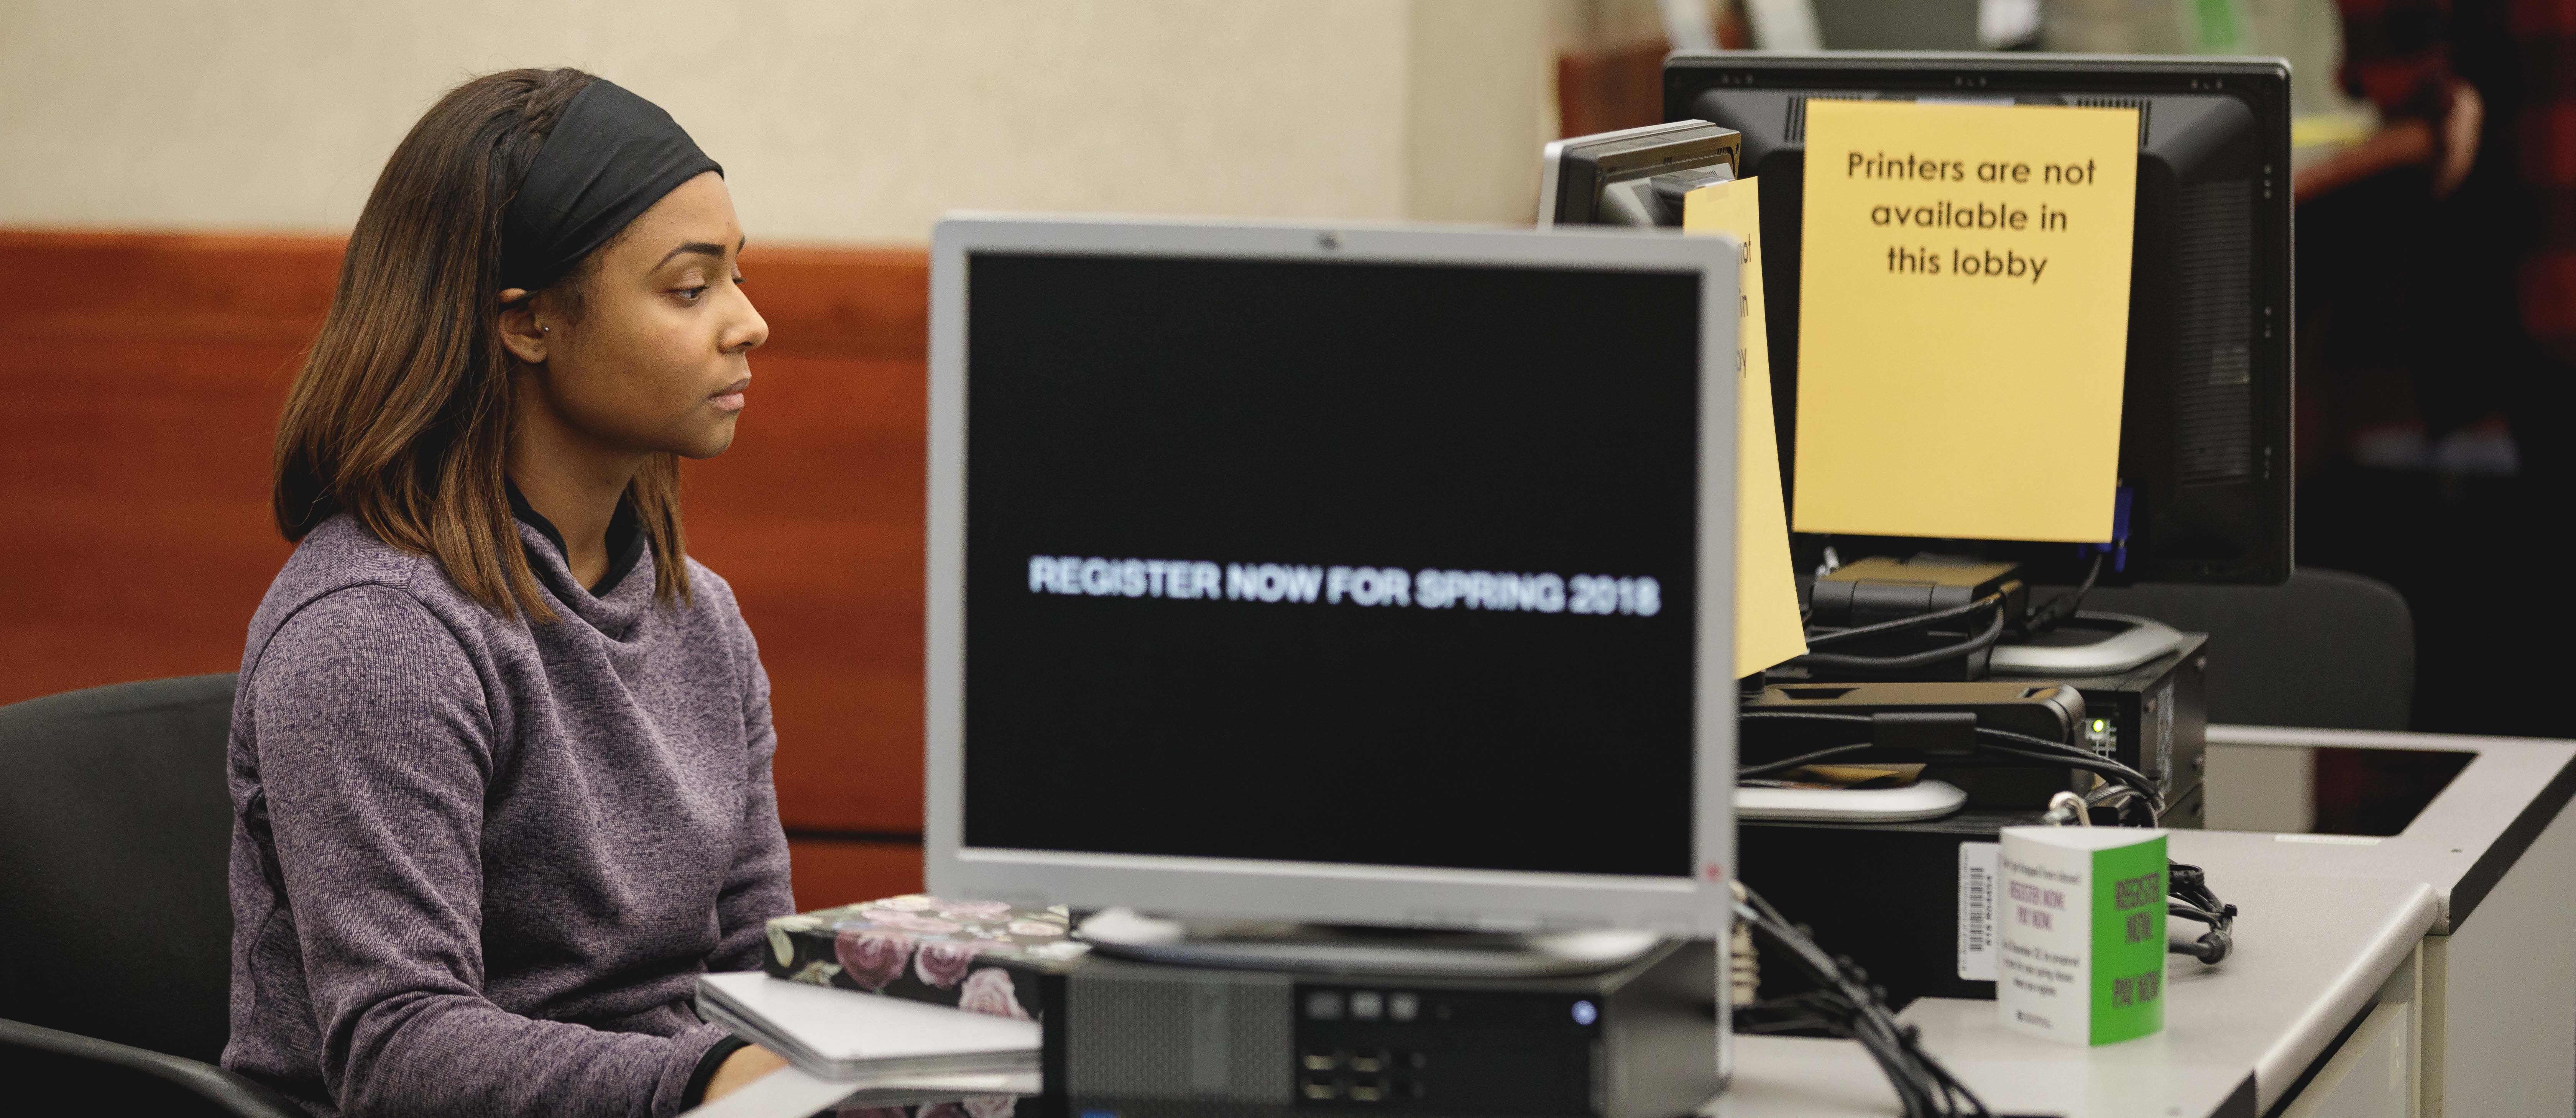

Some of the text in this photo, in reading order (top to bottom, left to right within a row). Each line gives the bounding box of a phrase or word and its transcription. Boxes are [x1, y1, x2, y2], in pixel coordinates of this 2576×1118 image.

[1847, 151, 2097, 186] Printers are not
[1870, 199, 2068, 232] available in
[1886, 245, 2049, 285] this lobby
[1028, 555, 1661, 617] REGISTER NOW FOR SPRING 2018
